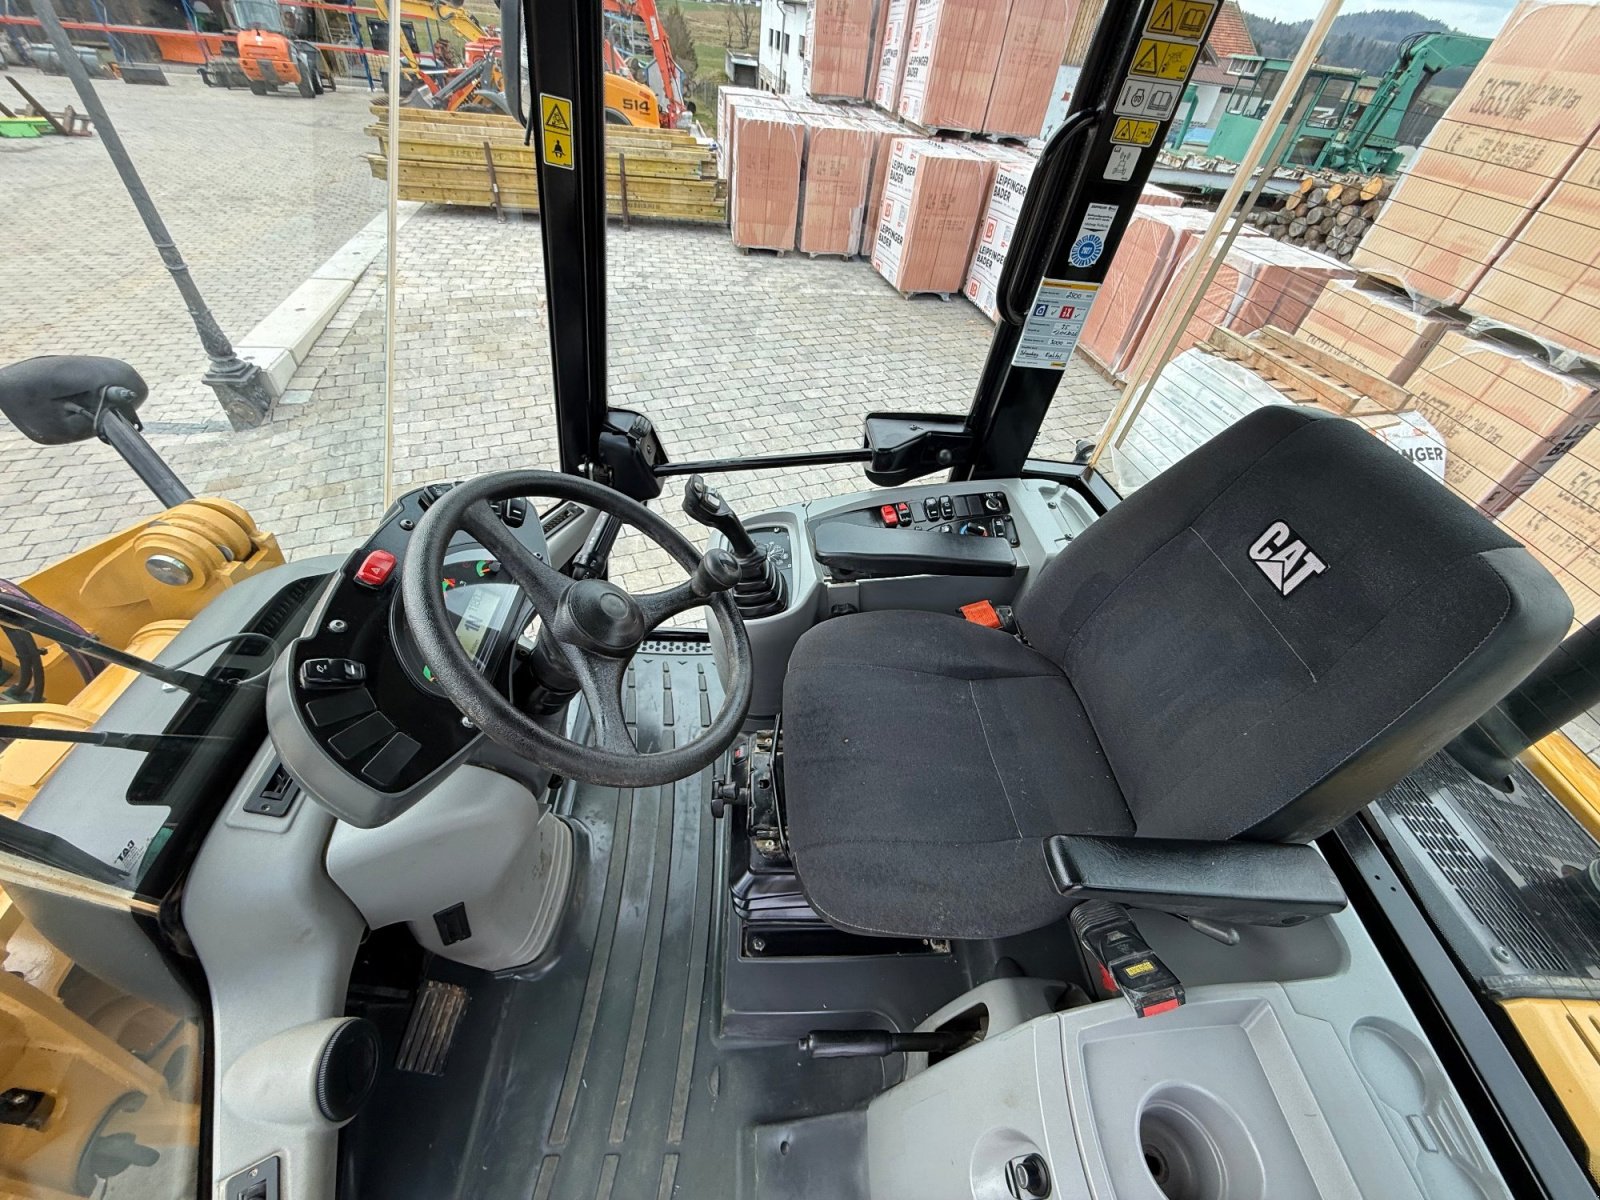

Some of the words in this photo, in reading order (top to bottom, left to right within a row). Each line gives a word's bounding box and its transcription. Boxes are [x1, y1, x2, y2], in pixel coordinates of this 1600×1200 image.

[623, 98, 650, 112] 514
[892, 159, 916, 177] LEIPFINGER
[890, 172, 904, 185] BADER
[996, 173, 1027, 197] LEIPFINGER
[993, 185, 1011, 202] BADER
[878, 235, 892, 249] BADER
[880, 224, 904, 245] LEIPFINGER
[976, 254, 993, 269] BADER
[979, 245, 1005, 265] LEIPFINGE
[1398, 446, 1443, 462] NGER
[1249, 521, 1327, 596] CAT
